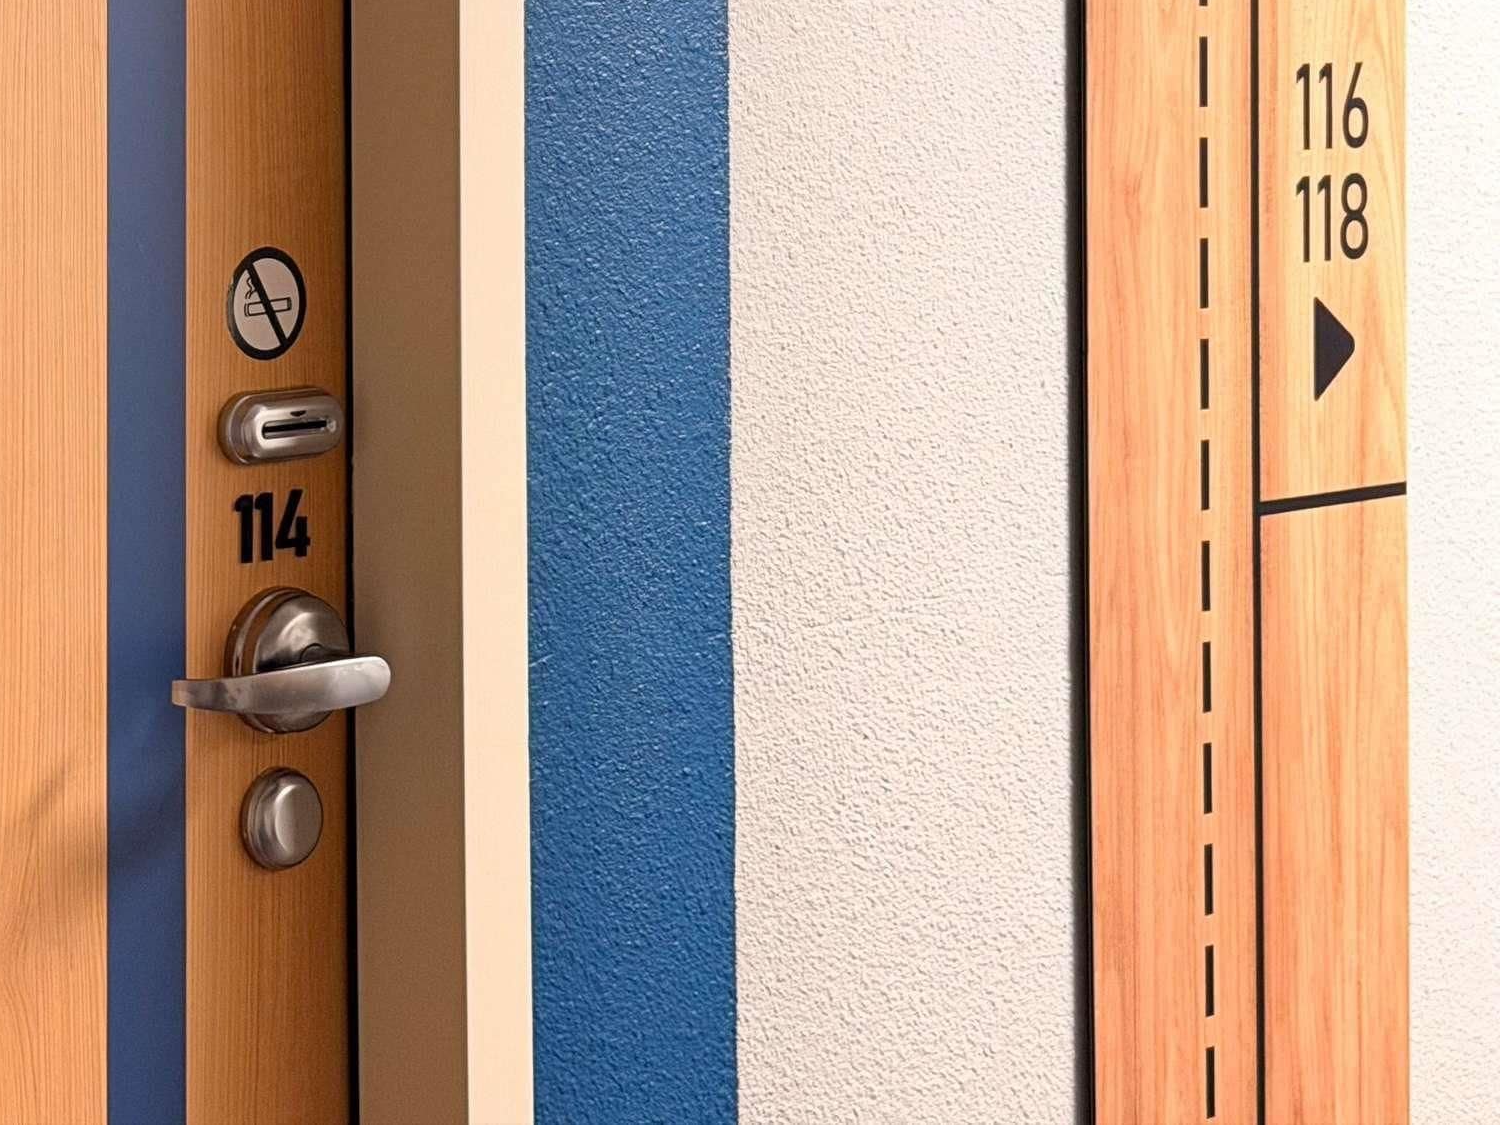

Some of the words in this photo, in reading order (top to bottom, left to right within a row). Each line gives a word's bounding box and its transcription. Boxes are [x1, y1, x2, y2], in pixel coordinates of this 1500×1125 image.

[1296, 62, 1369, 150] 116
[1295, 172, 1369, 263] 118
[233, 488, 311, 564] 114
